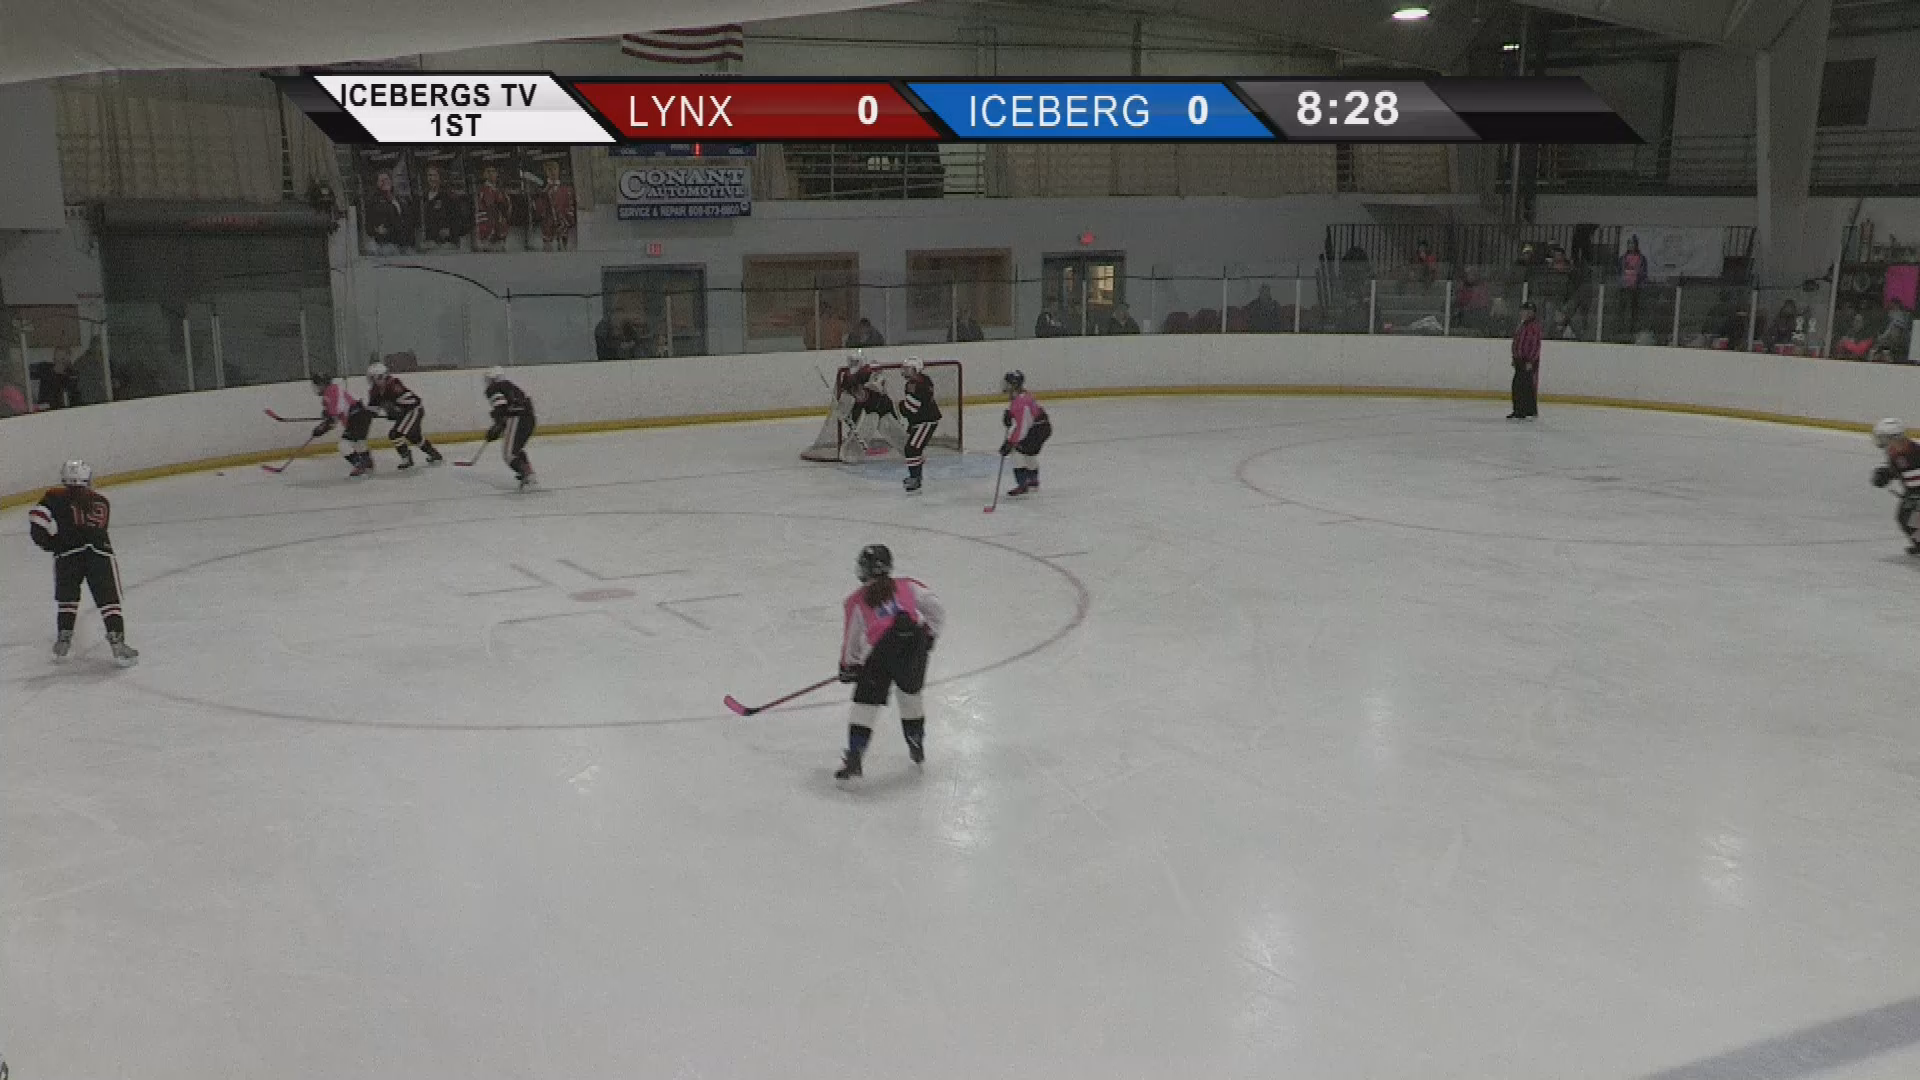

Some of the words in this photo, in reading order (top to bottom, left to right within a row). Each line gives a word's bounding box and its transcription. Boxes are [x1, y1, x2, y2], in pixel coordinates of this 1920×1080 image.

[619, 169, 744, 200] CONANT
[647, 185, 745, 197] AUTOMOTIVE
[619, 207, 650, 217] SERVICE
